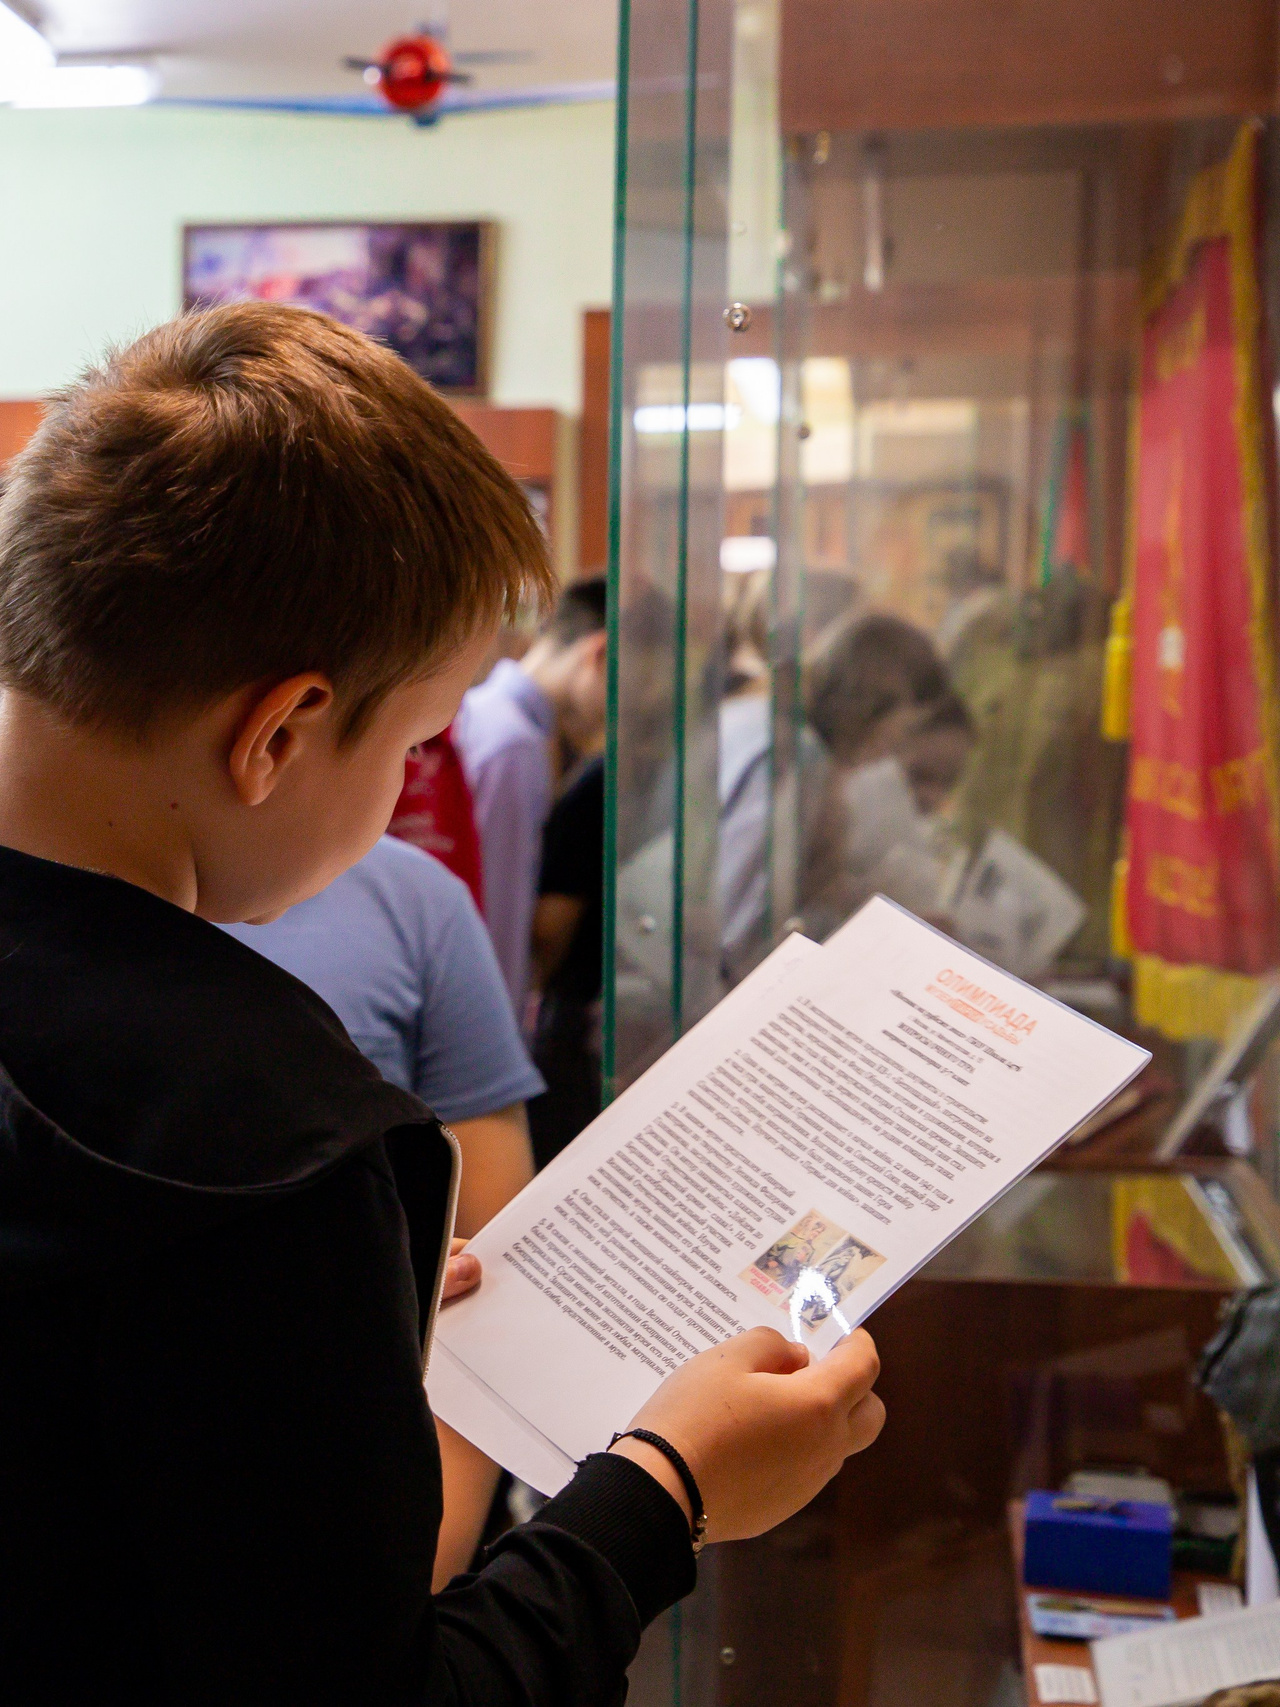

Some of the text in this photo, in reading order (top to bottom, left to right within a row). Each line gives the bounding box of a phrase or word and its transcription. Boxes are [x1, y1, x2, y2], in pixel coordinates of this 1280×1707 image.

[934, 967, 1040, 1035] ОЛИМПИАДА
[548, 1274, 578, 1302] Запишите
[582, 1305, 601, 1322] менее
[596, 1319, 613, 1333] двух
[610, 1330, 632, 1349] любых
[555, 1264, 575, 1283] Среди
[601, 1305, 634, 1333] экспонатов
[632, 1331, 651, 1347] музея
[648, 1345, 663, 1357] есть
[645, 1308, 675, 1333] Великой
[665, 1300, 688, 1319] солдат
[693, 1305, 727, 1334] Запишите
[638, 1319, 677, 1353] боеприпасов
